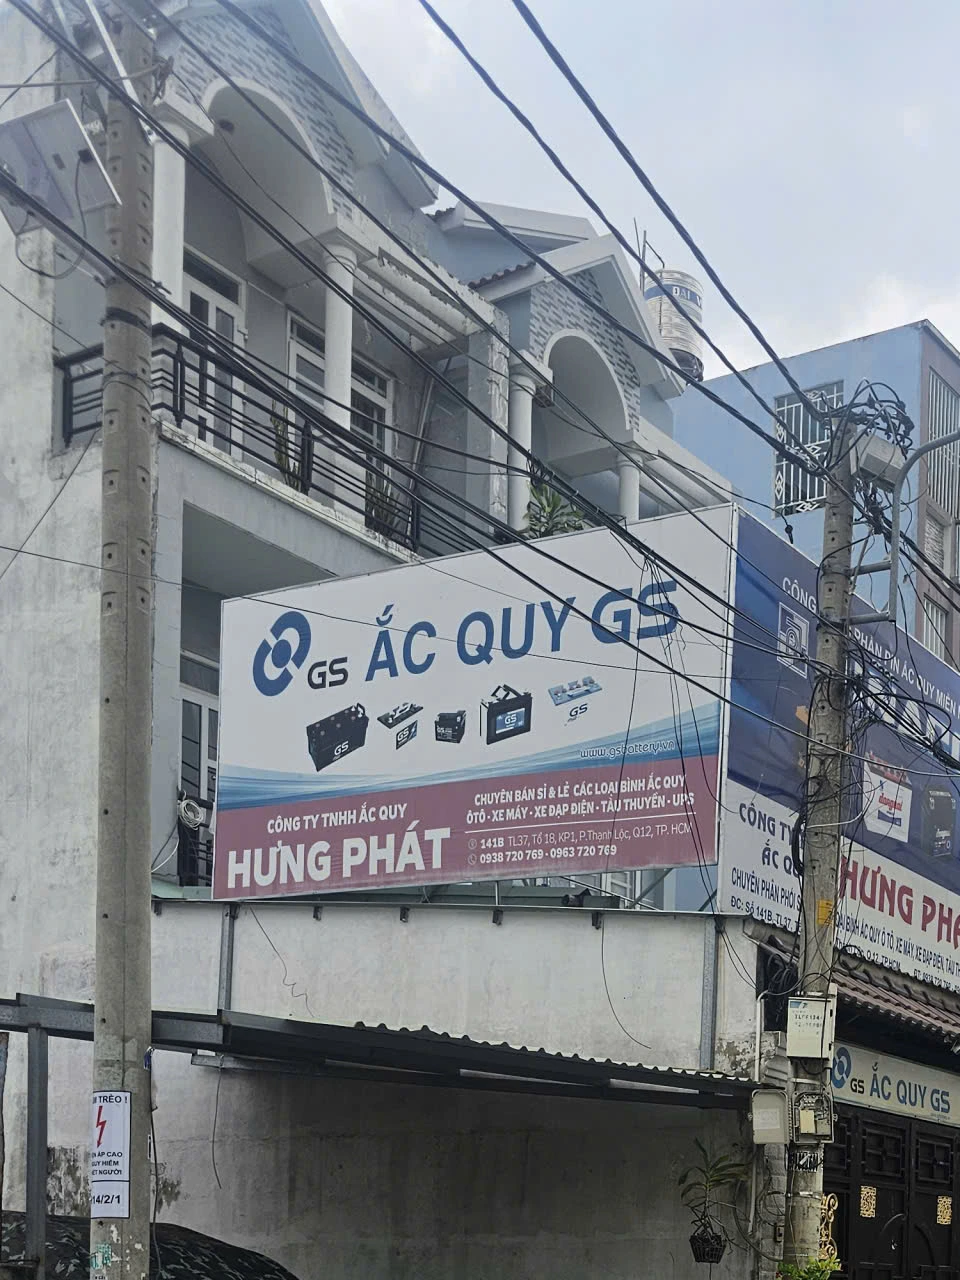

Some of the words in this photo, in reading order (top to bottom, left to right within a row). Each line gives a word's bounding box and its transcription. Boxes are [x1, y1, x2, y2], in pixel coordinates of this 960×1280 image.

[307, 656, 349, 690] GS
[365, 604, 437, 681] ẮC
[456, 596, 577, 666] QUY
[591, 580, 679, 644] GS
[504, 714, 517, 724] GS
[569, 703, 588, 718] GS
[334, 741, 349, 756] GS
[398, 727, 410, 742] GS
[474, 788, 513, 806] CHUYÊN
[515, 786, 535, 802] BÁN
[548, 786, 556, 799] &
[573, 781, 593, 796] CÁC
[595, 781, 619, 797] LOẠI
[620, 776, 646, 793] BÌNH
[647, 772, 662, 791] ẮC
[663, 774, 687, 789] QUY
[267, 815, 301, 834] CÔNG
[303, 814, 320, 830] TY
[321, 809, 357, 828] TNHH
[359, 802, 376, 823] ẮC
[379, 803, 408, 821] QUY
[466, 808, 486, 824] ÔTÔ
[492, 809, 505, 822] XE
[506, 805, 528, 821] MÁY
[534, 805, 548, 818] XE
[549, 803, 569, 819] ĐẠP
[570, 799, 595, 817] ĐIỆN
[601, 798, 622, 813] TÀU
[623, 792, 666, 811] THUYỀN
[672, 792, 695, 807] UPS
[739, 802, 776, 836] CÔNG
[228, 840, 332, 889] HƯNG
[343, 819, 451, 879] PHÁT
[480, 837, 505, 849] 141B
[480, 851, 504, 864] 0938
[505, 850, 524, 862] 720
[525, 849, 545, 859] 769
[550, 847, 575, 858] 0963
[577, 845, 596, 857] 720
[597, 844, 618, 856] 769
[762, 839, 779, 869] ẮC
[731, 867, 760, 896] CHUYÊN
[760, 879, 779, 904] PHÂN
[839, 854, 914, 925] HƯNG
[731, 895, 744, 911] ĐC:
[98, 1094, 122, 1104] TRÈO
[850, 1078, 865, 1094] GS
[870, 1062, 891, 1101] ẮC
[897, 1080, 927, 1109] QUY
[931, 1088, 950, 1114] GS
